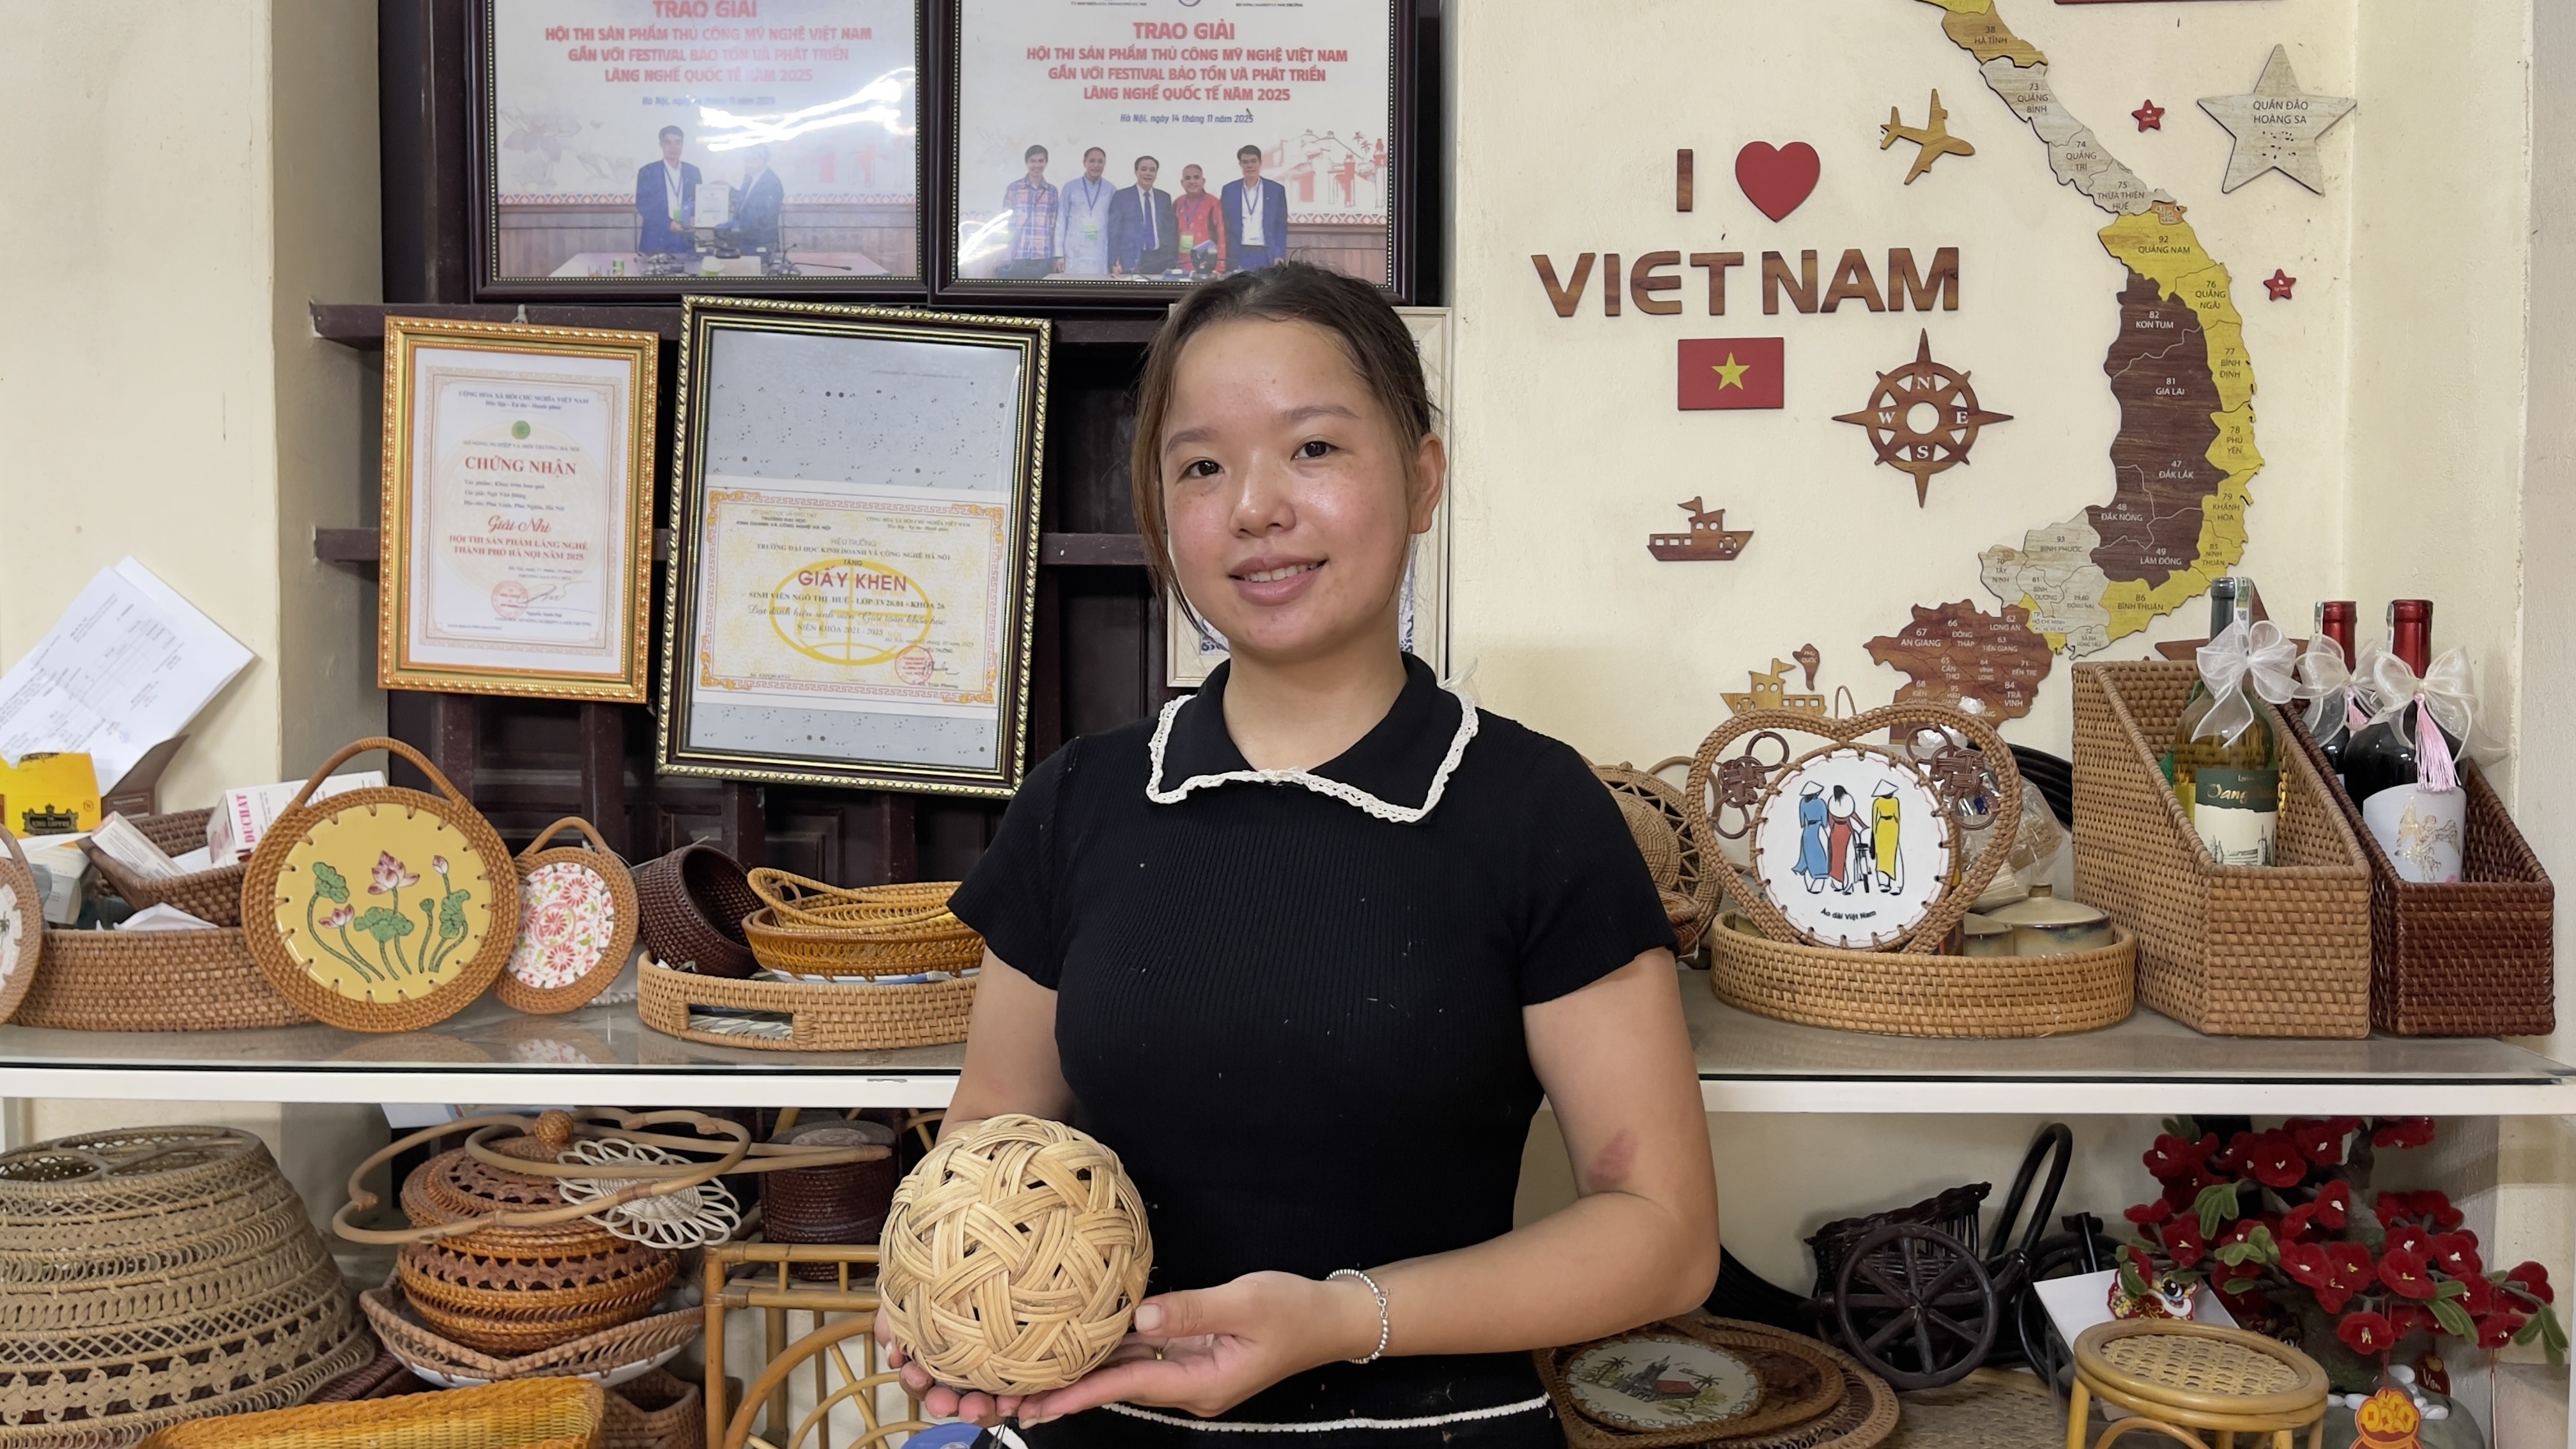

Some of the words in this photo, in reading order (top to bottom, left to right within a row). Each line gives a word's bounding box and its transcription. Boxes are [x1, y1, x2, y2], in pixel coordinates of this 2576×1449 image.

[653, 0, 709, 18] TRAO
[574, 28, 595, 41] THI
[841, 29, 871, 40] NAM
[1133, 22, 1188, 40] TRAO
[1193, 19, 1235, 40] GIẢI
[629, 49, 686, 61] FESTIVAL
[1027, 46, 1050, 63] HỘI
[1054, 48, 1075, 61] THI
[1078, 47, 1105, 61] SẢN
[1151, 47, 1176, 61] THỦ
[1181, 47, 1218, 62] CÔNG
[1285, 47, 1313, 64] VIỆT
[1318, 50, 1347, 62] NAM
[779, 70, 813, 82] 2025
[1108, 68, 1165, 80] FESTIVAL
[1169, 66, 1197, 80] BẢO
[1230, 66, 1248, 81] VÀ
[1253, 66, 1285, 82] PHÁT
[1084, 86, 1119, 100] LÀNG
[1257, 89, 1291, 101] 2025
[2017, 93, 2048, 103] QUẢNG
[2027, 103, 2047, 113] BÌNH
[2286, 98, 2308, 110] ĐẢO
[1234, 114, 1254, 123] 2025
[2253, 113, 2292, 124] HOÀNG
[2294, 115, 2307, 124] SA
[2066, 151, 2096, 160] QUẢNG
[1676, 149, 1693, 211] I
[2138, 245, 2168, 254] QUẢNG
[1531, 250, 1744, 318] VIET
[1761, 247, 1959, 315] NAM
[2195, 289, 2226, 298] QUẢNG
[2156, 321, 2174, 329] TUM
[1916, 377, 1931, 390] N
[1878, 411, 1896, 424] W
[1956, 411, 1968, 424] E
[1917, 445, 1929, 459] S
[465, 455, 523, 472] CHỨNG
[530, 458, 576, 478] NHẬN
[2212, 502, 2240, 510] KHÁNH
[2119, 512, 2143, 522] NÔNG
[2140, 556, 2157, 565] LÂM
[798, 565, 848, 588] GIẤY
[856, 574, 906, 592] KHEN
[1916, 628, 1927, 636] 67
[1914, 639, 1941, 647] GIANG
[1860, 910, 1876, 919] Nam
